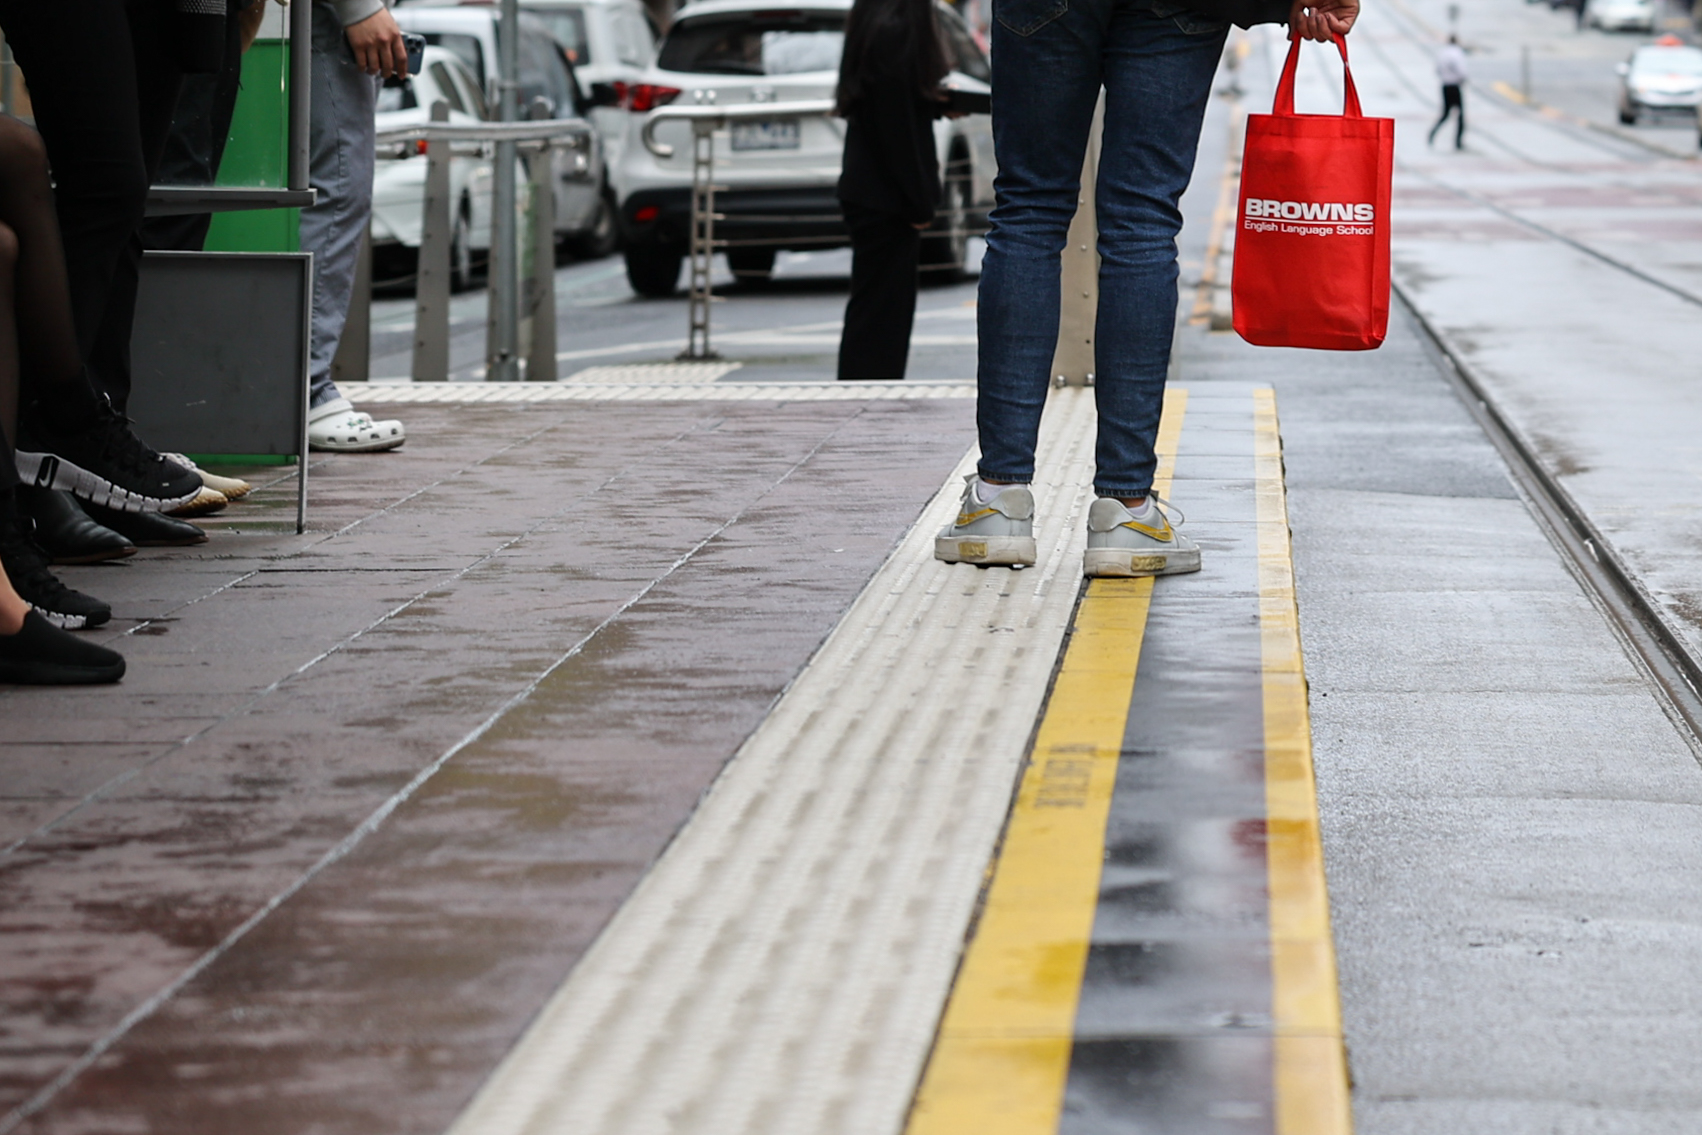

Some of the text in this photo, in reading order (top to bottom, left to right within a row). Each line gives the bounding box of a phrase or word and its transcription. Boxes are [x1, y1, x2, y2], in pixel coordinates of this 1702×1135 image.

[1245, 197, 1375, 222] BROWNS
[1244, 220, 1374, 237] English Language School
